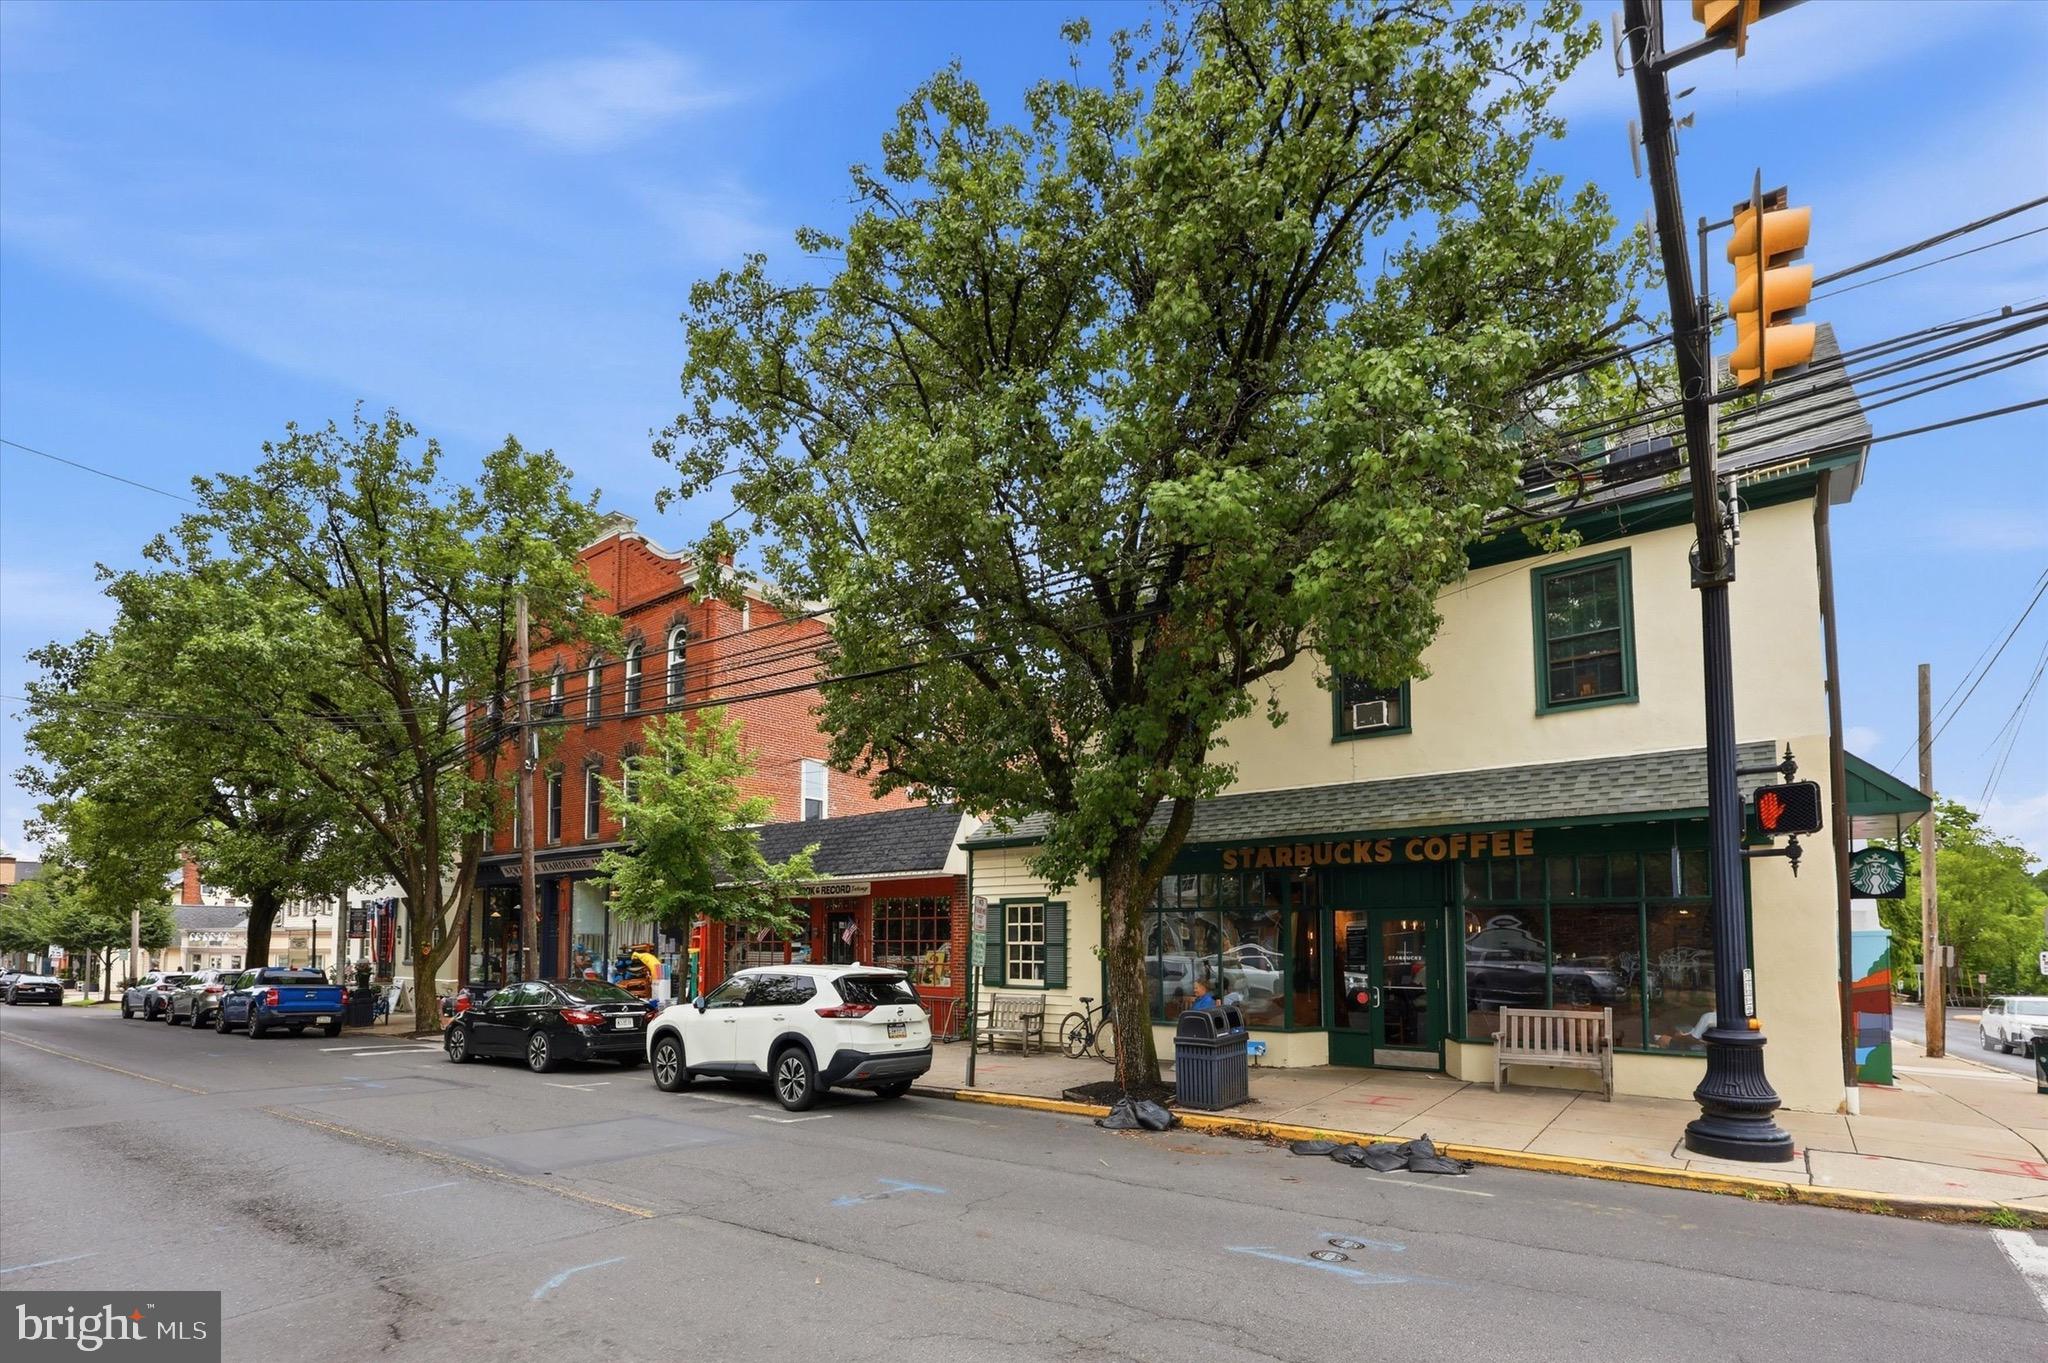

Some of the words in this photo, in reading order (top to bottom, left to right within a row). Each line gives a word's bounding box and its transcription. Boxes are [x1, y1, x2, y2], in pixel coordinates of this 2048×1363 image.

[1222, 839, 1393, 871] STARBUCKS
[1405, 829, 1535, 862] COFFEE
[541, 859, 590, 872] HARDWARE
[821, 885, 851, 895] RECORD
